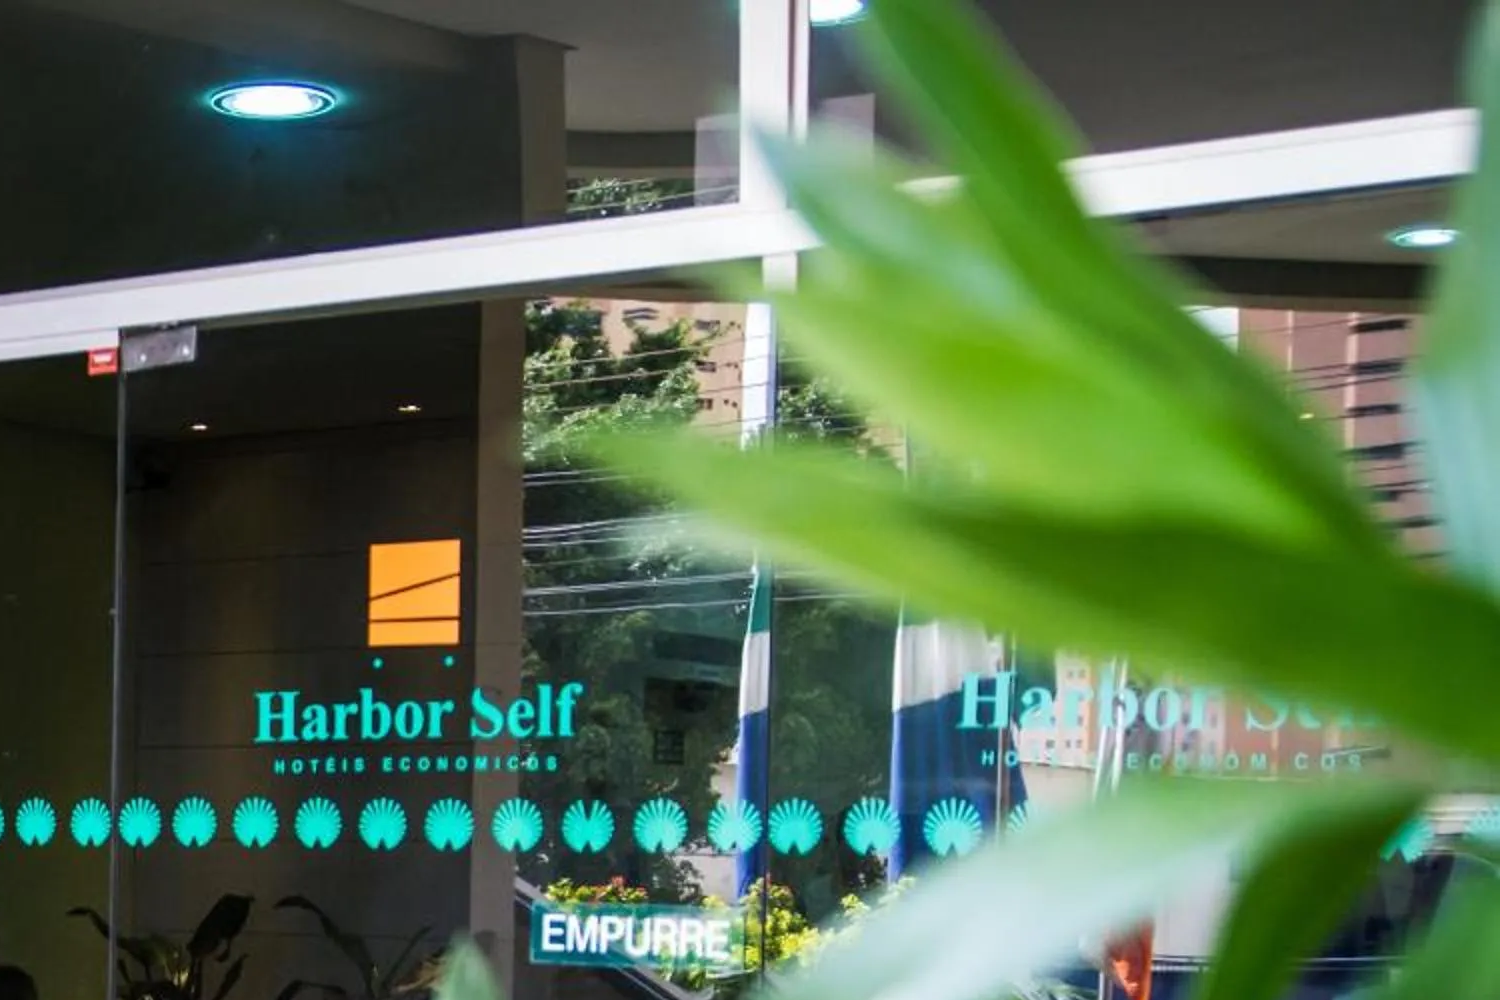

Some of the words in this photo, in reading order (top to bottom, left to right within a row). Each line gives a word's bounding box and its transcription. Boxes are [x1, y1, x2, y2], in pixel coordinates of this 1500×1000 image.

[254, 688, 454, 743] Harbor
[470, 683, 583, 738] Self
[955, 670, 1227, 731] Harbor
[540, 913, 731, 961] EMPURRE
